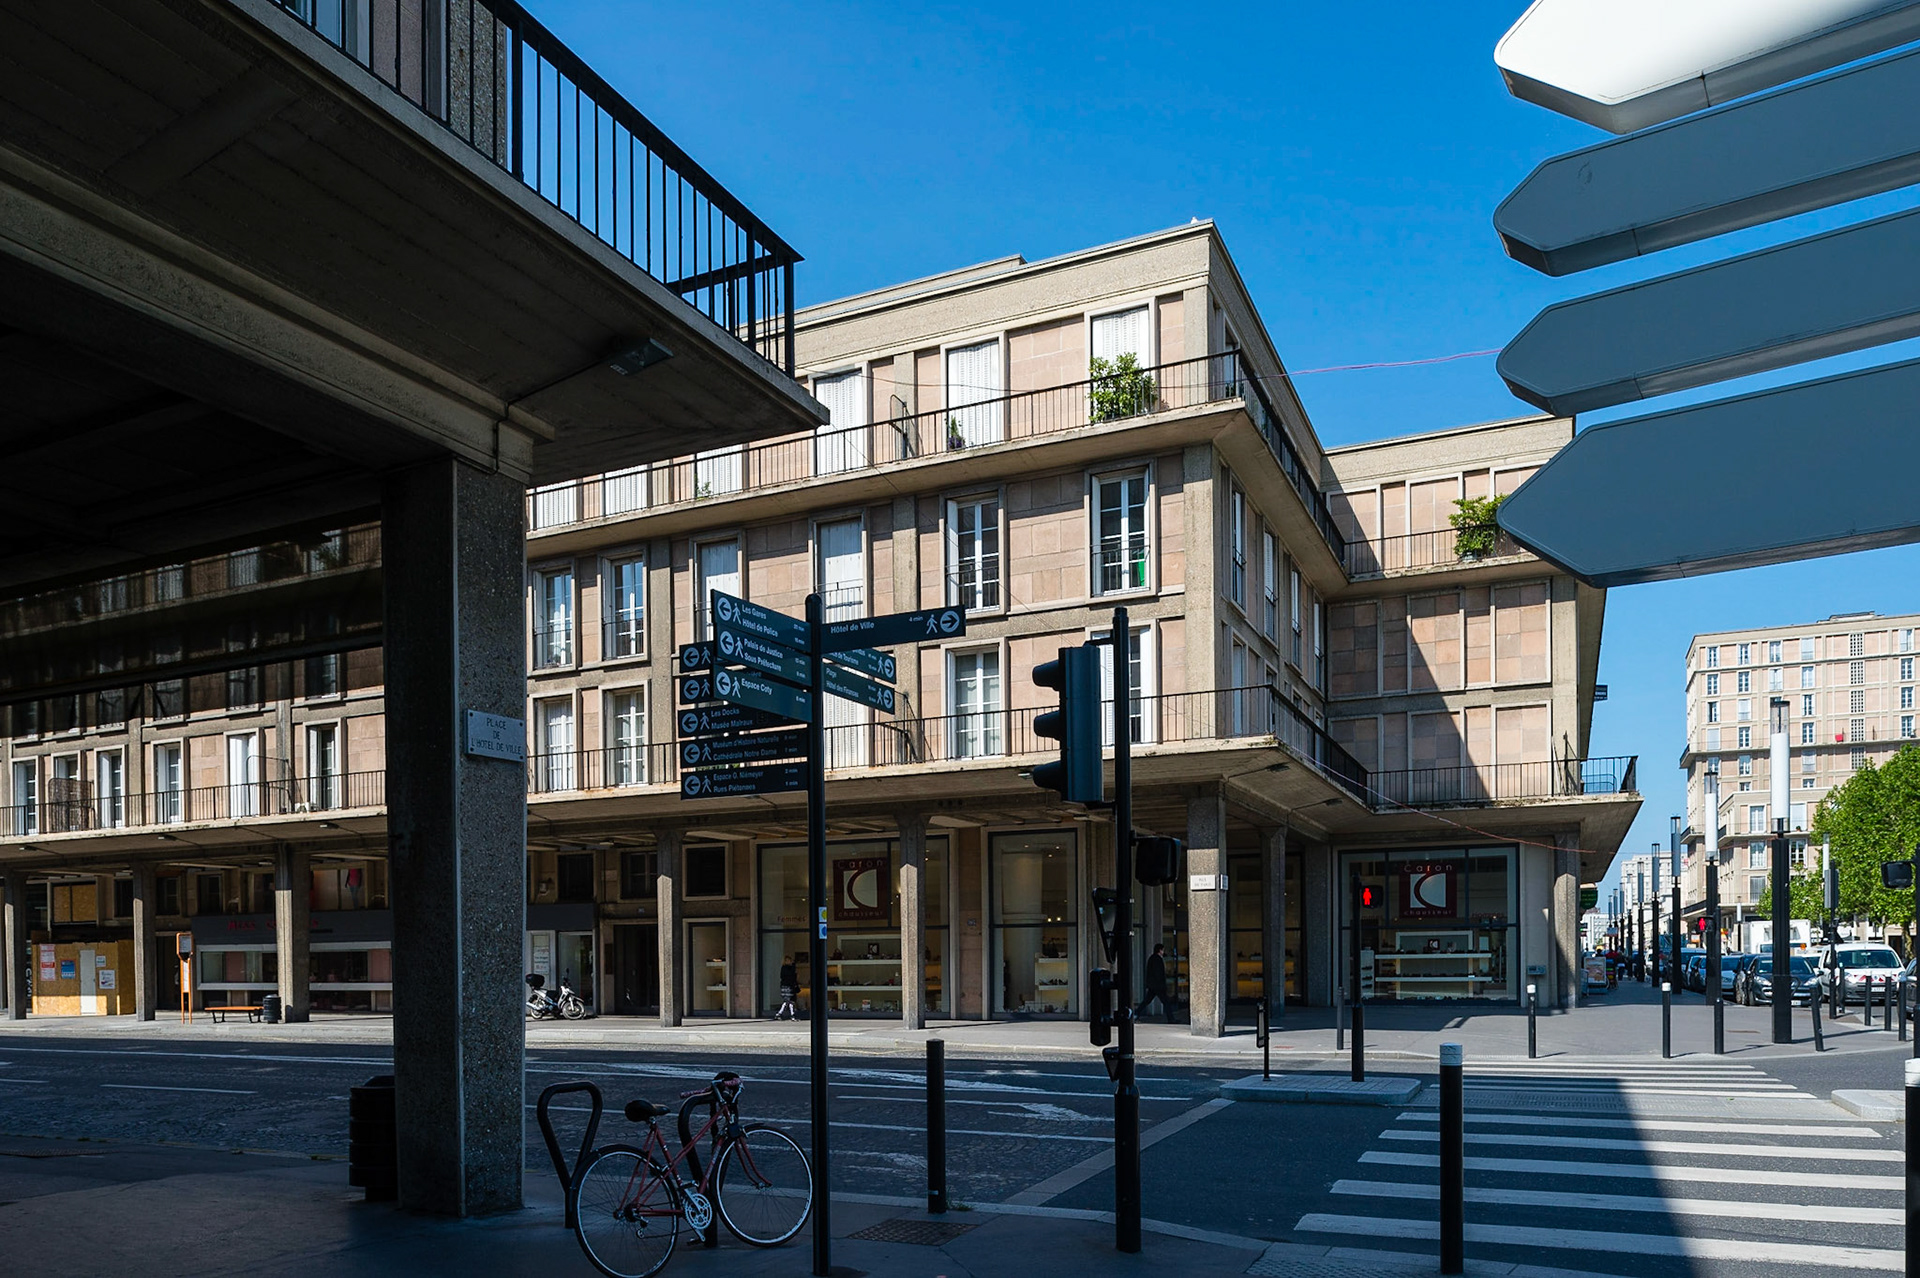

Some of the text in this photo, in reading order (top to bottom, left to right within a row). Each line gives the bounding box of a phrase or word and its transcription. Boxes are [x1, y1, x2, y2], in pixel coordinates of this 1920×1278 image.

[742, 604, 766, 619] Les Gares
[742, 618, 778, 637] Hôtel de Police
[831, 623, 848, 634] Hôtel
[860, 621, 875, 629] Ville
[744, 638, 758, 650] Palais
[760, 643, 766, 652] de
[766, 647, 783, 658] Justice
[744, 652, 781, 672] Sous Préfecture
[741, 678, 773, 696] Espace Coty
[487, 718, 506, 730] PLACE
[493, 731, 500, 740] DE
[496, 743, 504, 752] DE
[505, 744, 521, 755] VILLE
[838, 859, 883, 869] Caron
[1404, 864, 1453, 872] Caron
